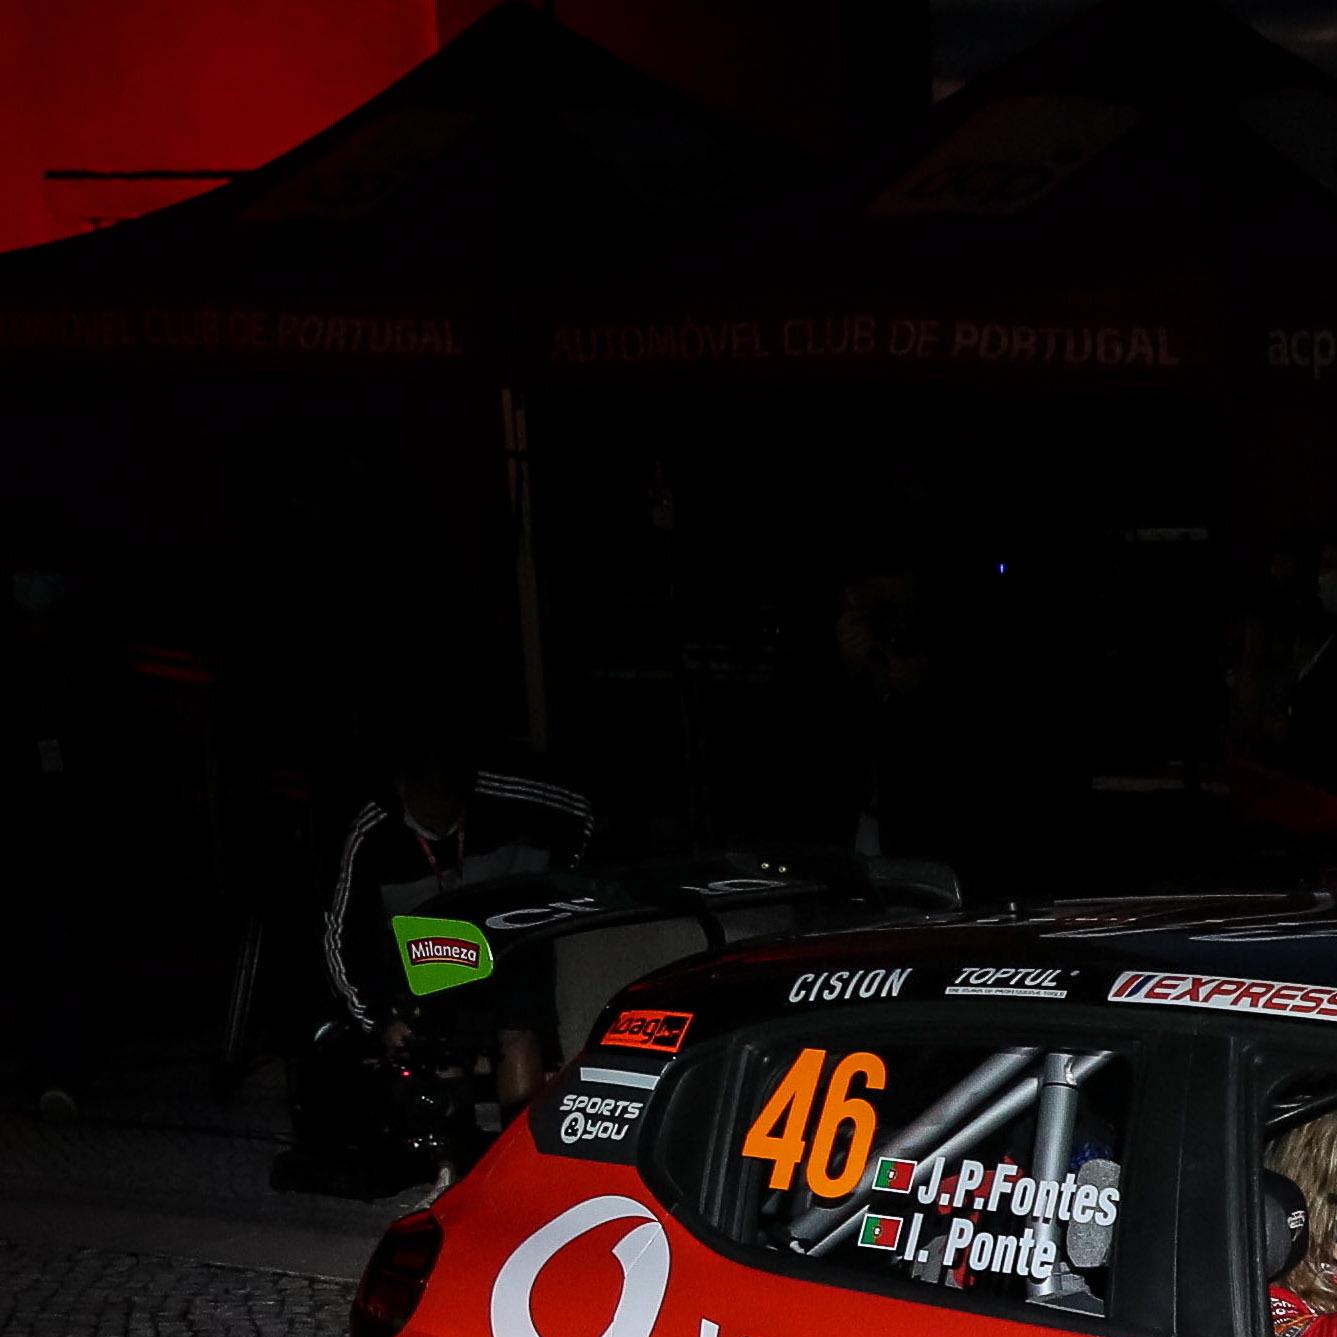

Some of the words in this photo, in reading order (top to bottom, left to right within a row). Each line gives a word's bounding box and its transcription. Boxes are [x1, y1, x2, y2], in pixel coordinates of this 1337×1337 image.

[276, 312, 465, 359] PORTUGAL
[782, 313, 877, 358] CLUB
[888, 317, 941, 360] DE
[949, 319, 1184, 368] PORTUGAL
[410, 939, 478, 963] Milaneza
[788, 967, 913, 1003] CISION
[953, 967, 1063, 987] TOPTUL
[560, 1094, 645, 1120] SPORTS
[741, 1047, 887, 1200] 46
[942, 1217, 1057, 1280] Ponte
